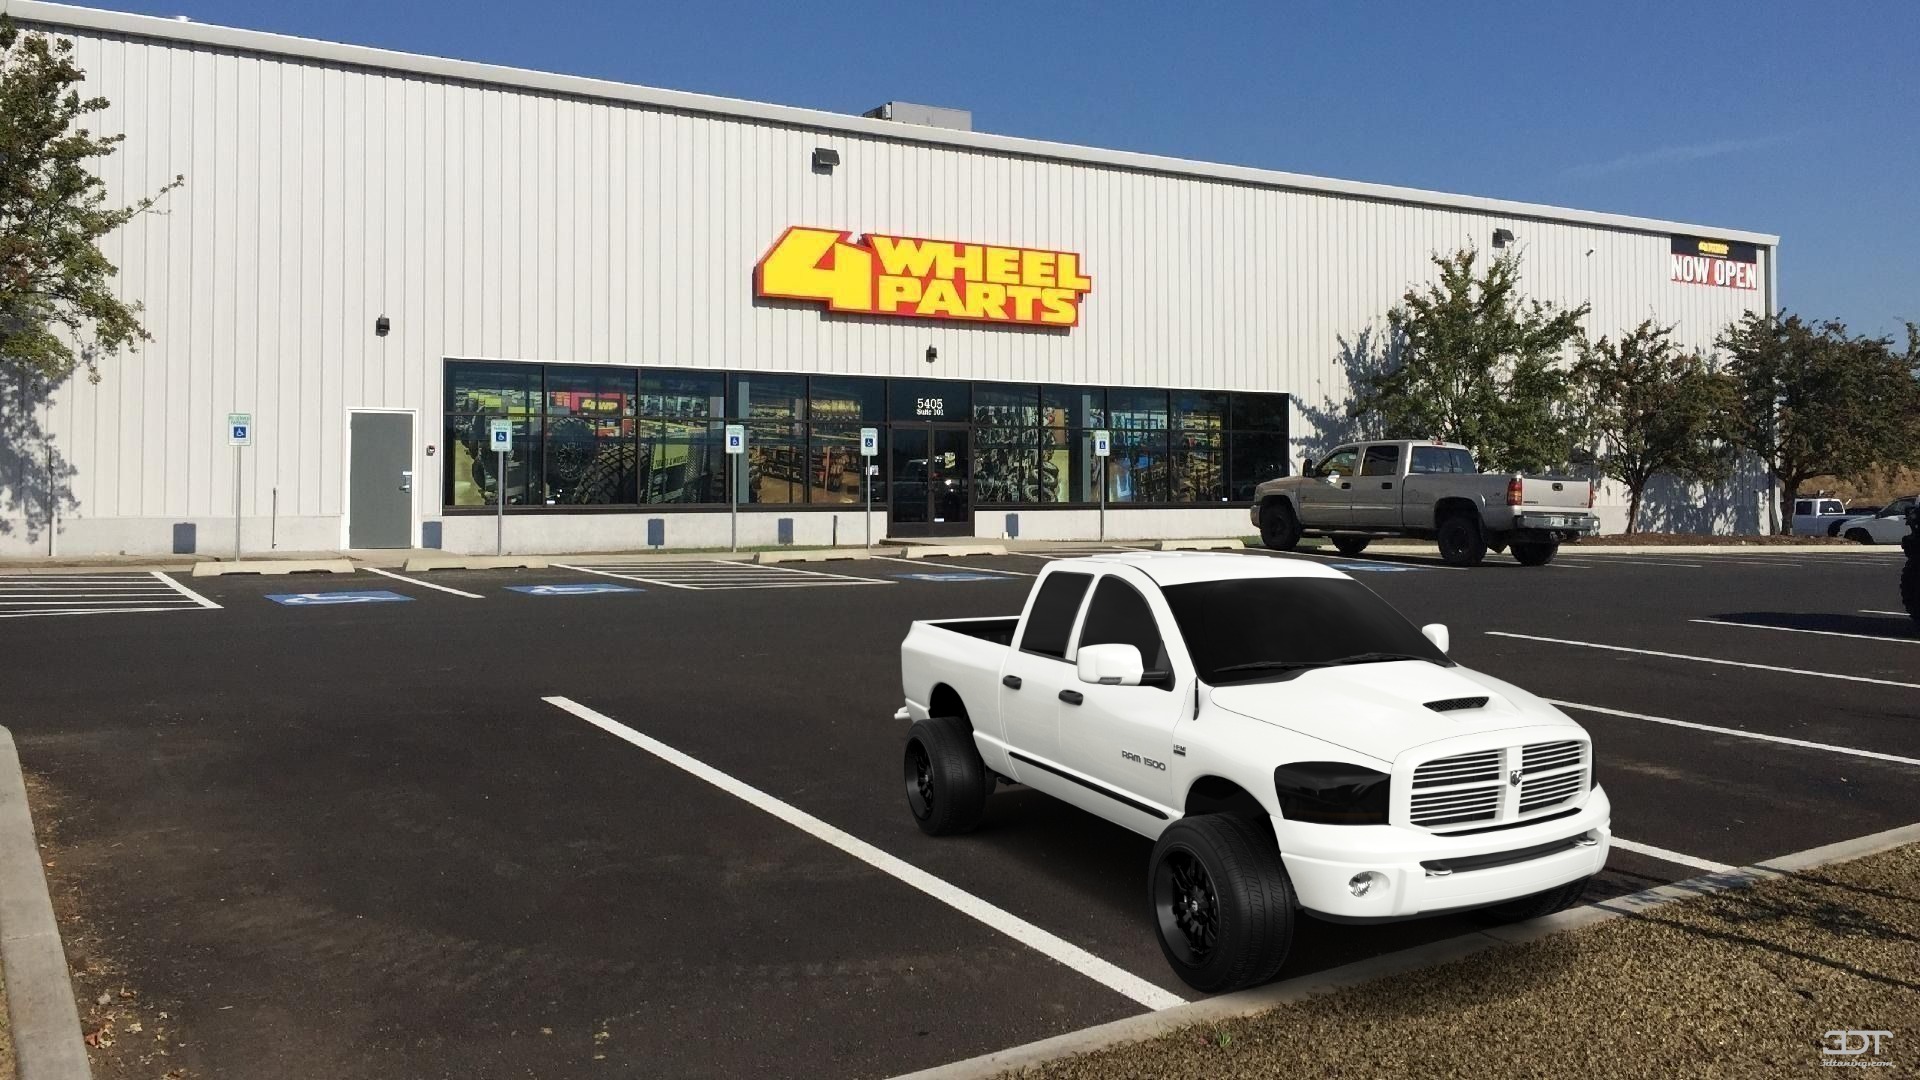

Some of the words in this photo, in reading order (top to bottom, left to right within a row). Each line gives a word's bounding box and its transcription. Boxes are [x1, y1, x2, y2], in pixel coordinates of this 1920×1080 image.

[762, 228, 873, 311] 4
[872, 236, 1091, 291] WHEEL
[1671, 254, 1710, 284] NOW
[1714, 259, 1757, 289] OPEN
[878, 274, 1078, 325] PARTS
[917, 398, 943, 409] 5405
[1121, 750, 1142, 763] RAM
[1143, 756, 1166, 771] 1500
